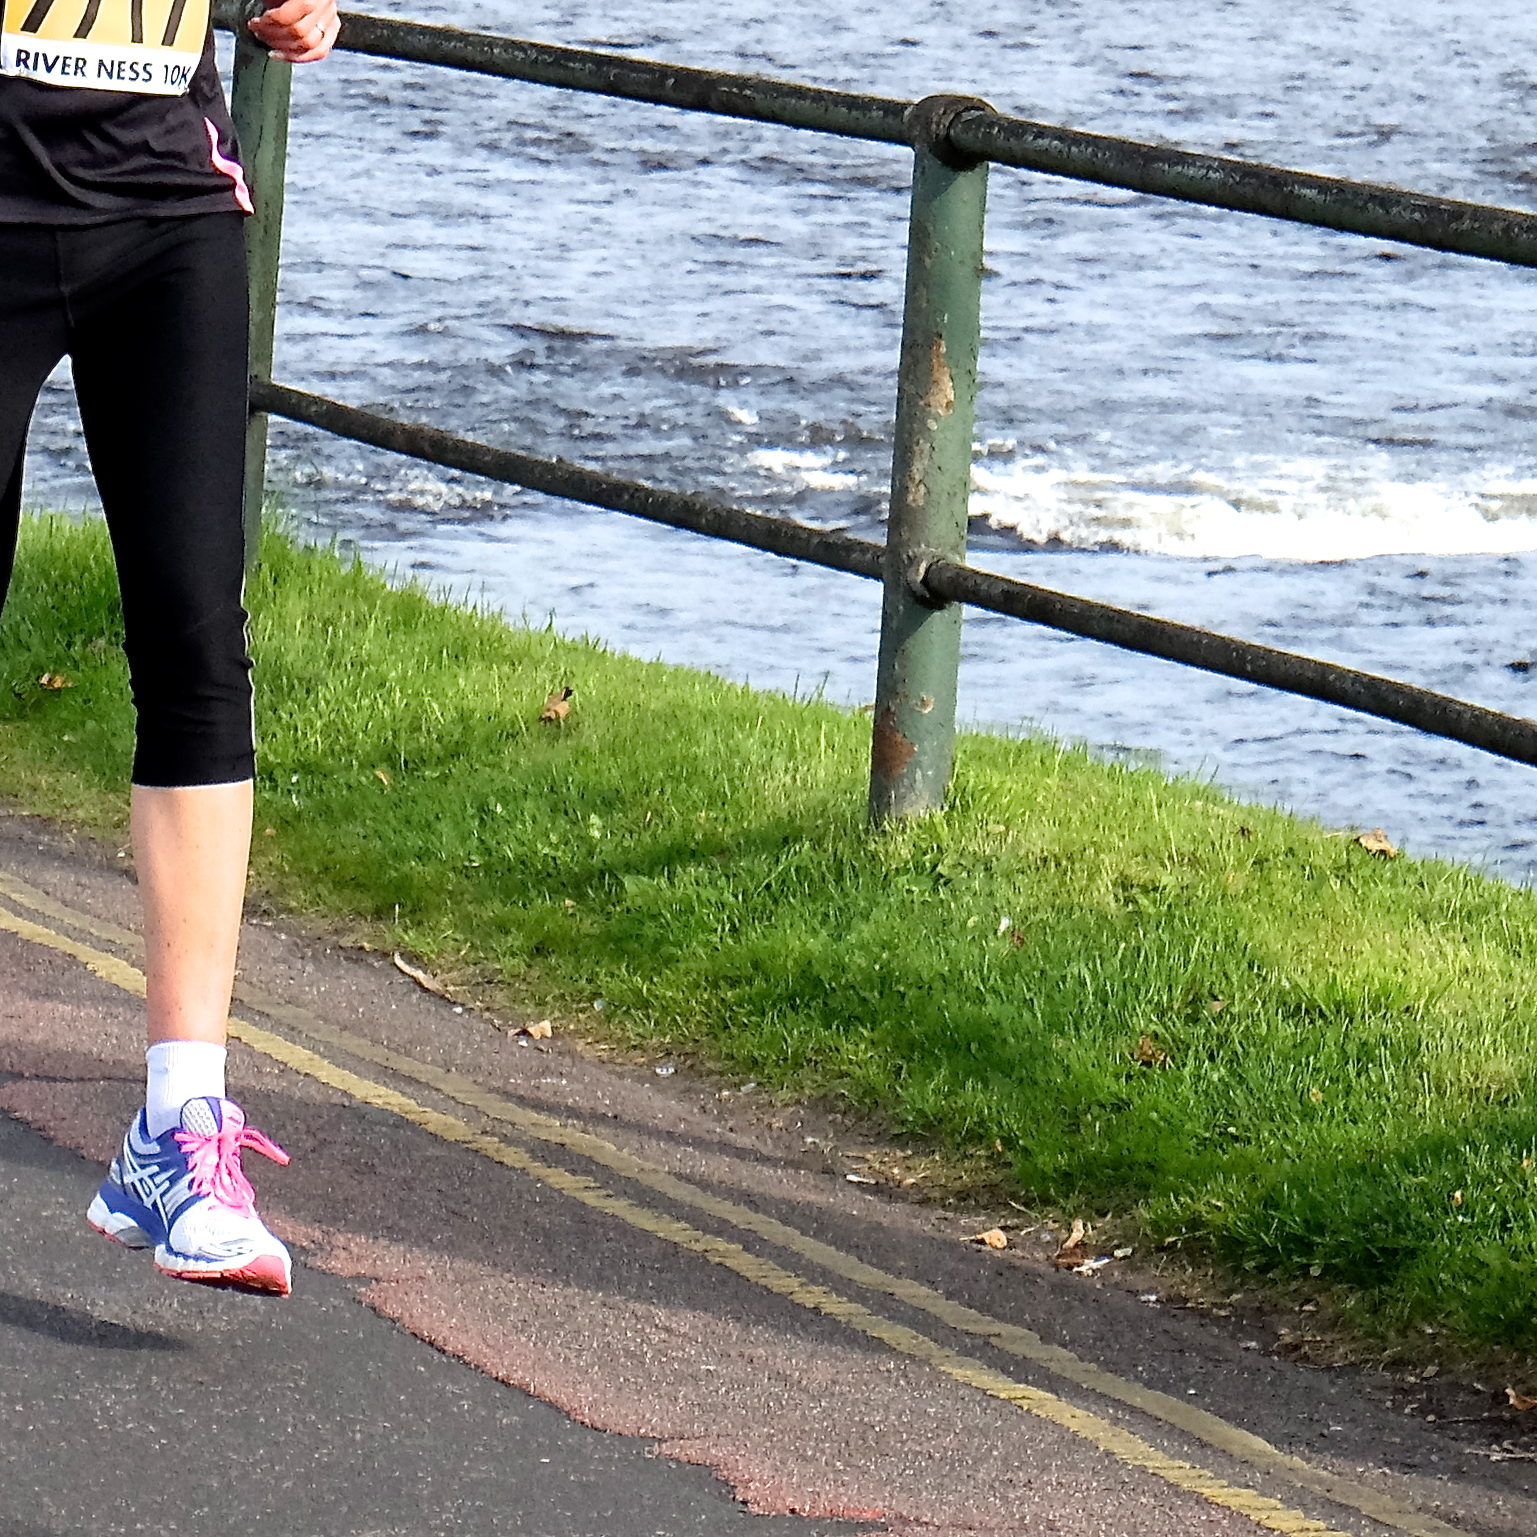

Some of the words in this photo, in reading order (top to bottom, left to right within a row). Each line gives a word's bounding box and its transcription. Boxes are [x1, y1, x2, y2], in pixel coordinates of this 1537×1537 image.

[15, 48, 87, 77] RIVER
[97, 59, 153, 83] NESS
[164, 65, 191, 86] 10K
